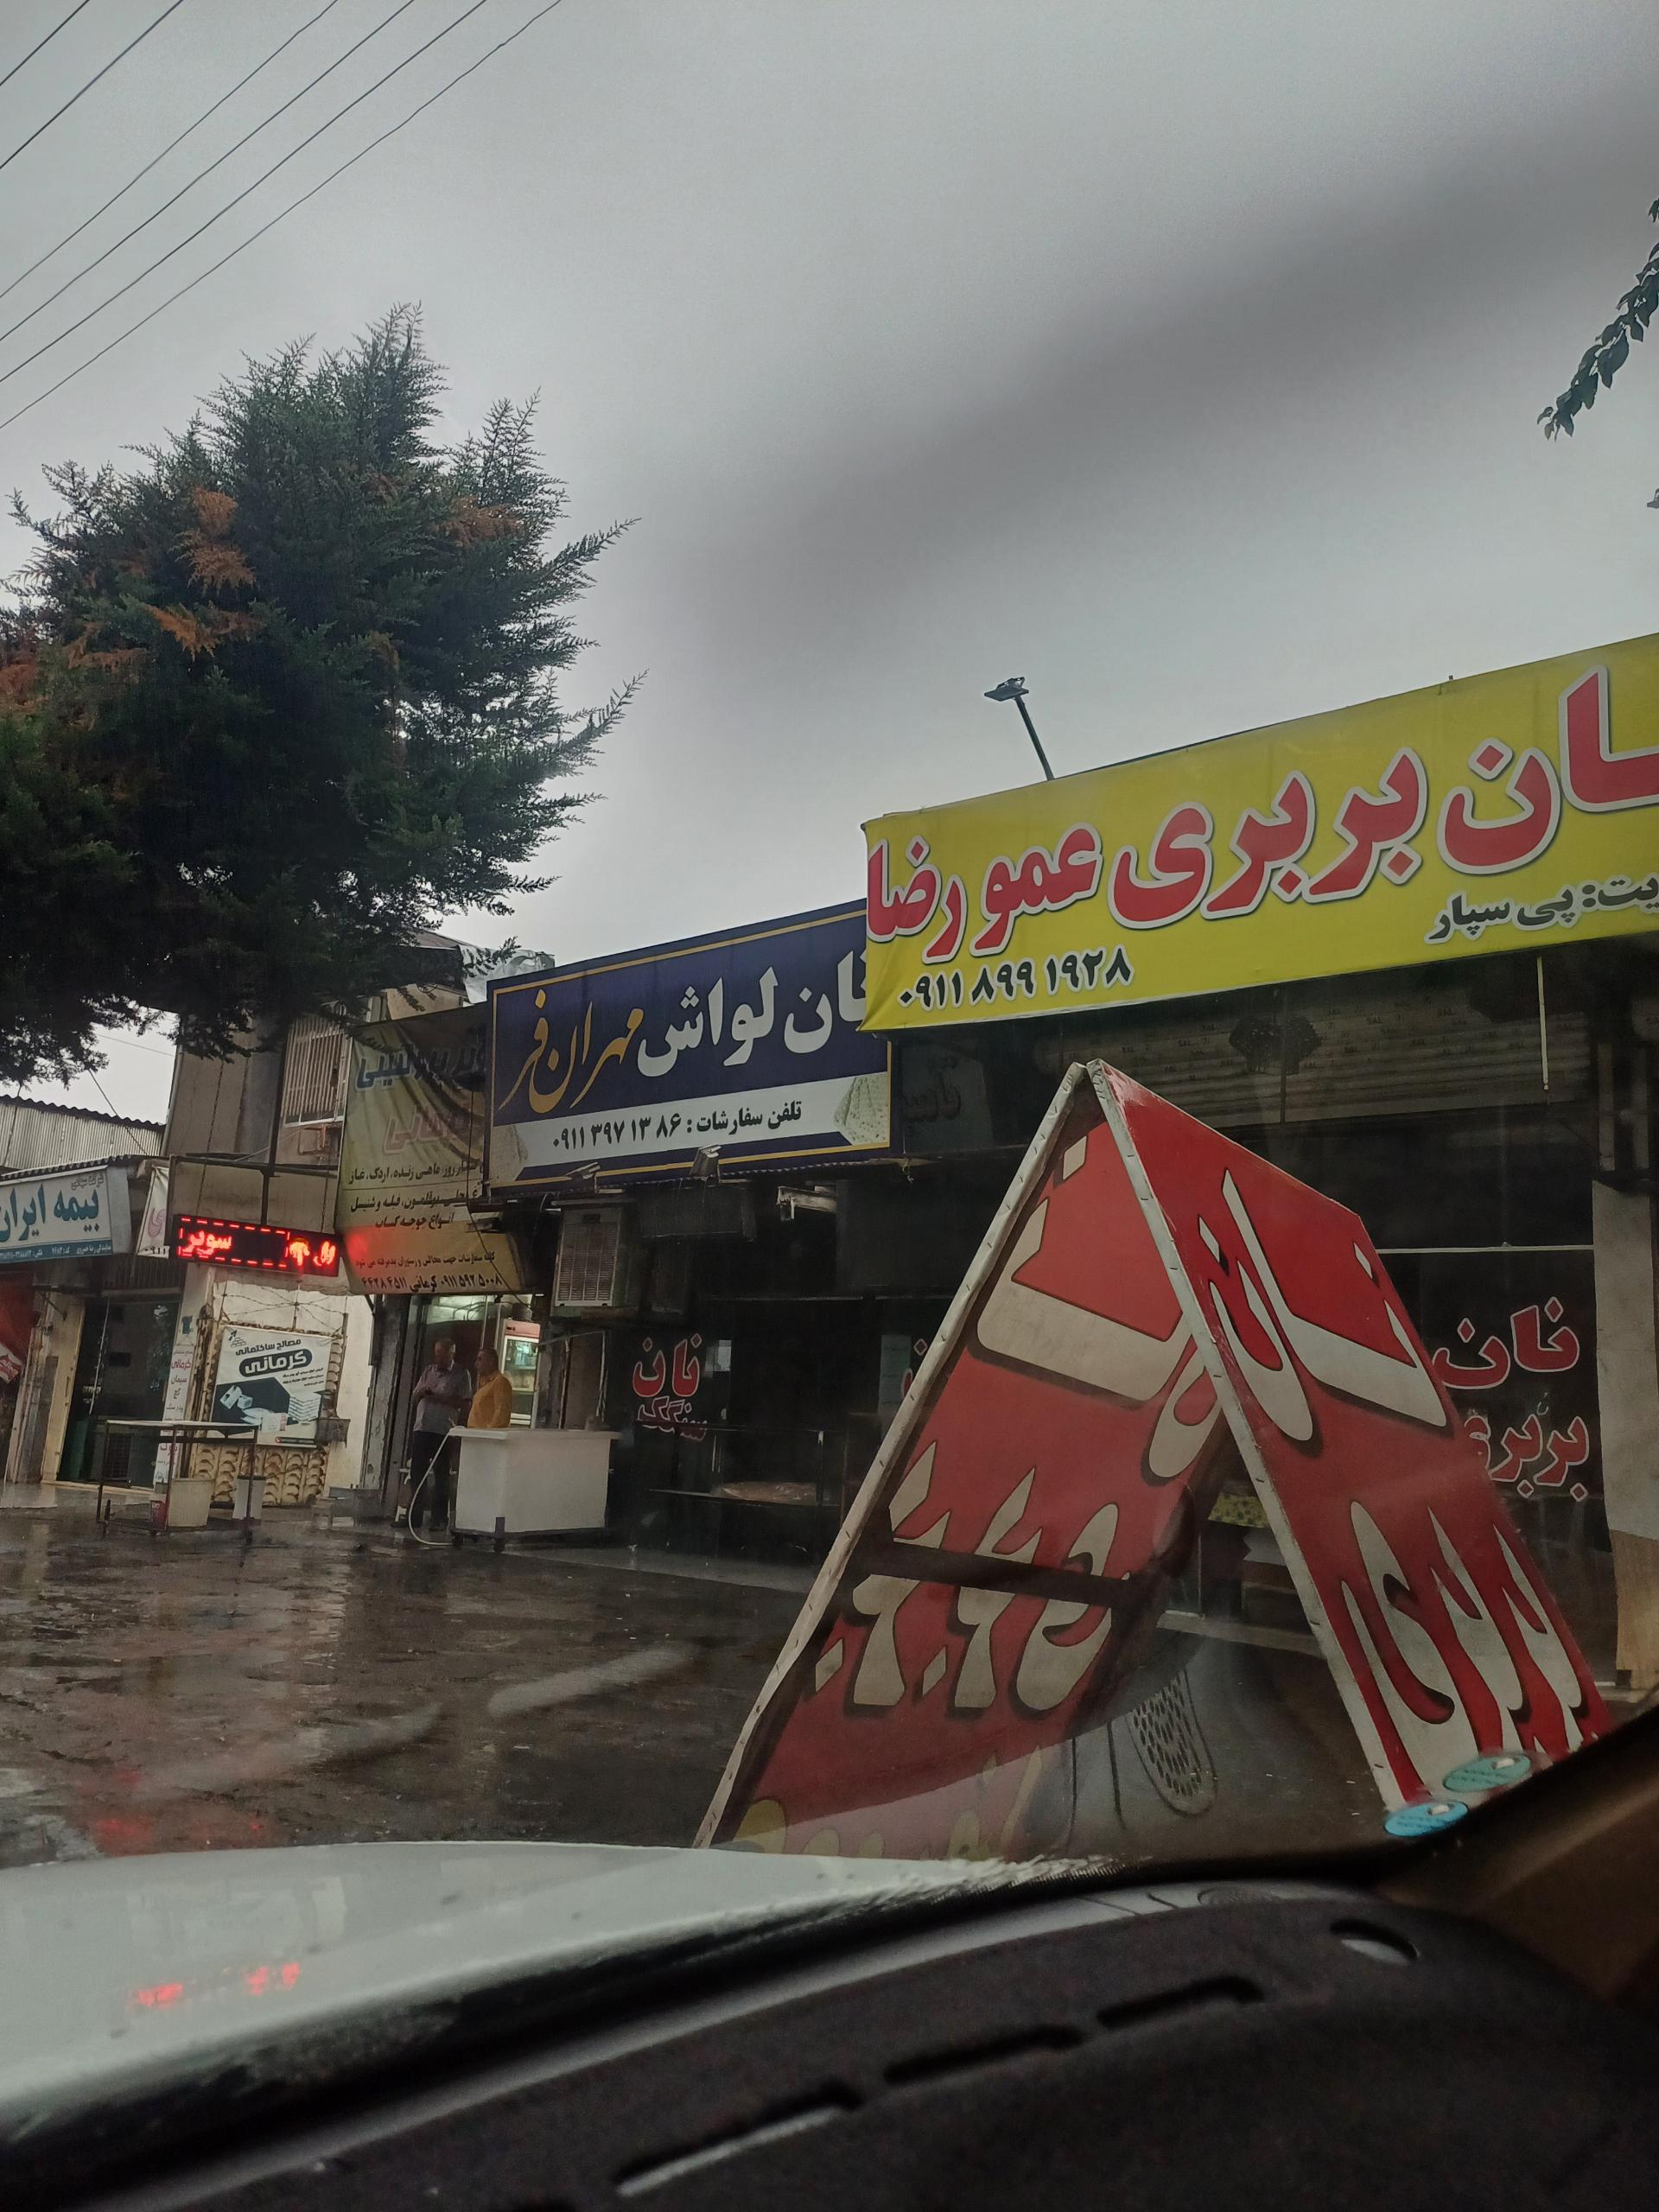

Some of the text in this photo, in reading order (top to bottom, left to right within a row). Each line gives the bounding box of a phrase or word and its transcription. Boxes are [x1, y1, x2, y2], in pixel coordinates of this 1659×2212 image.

[866, 665, 1659, 965] ان بربری عمو رضا
[1426, 893, 1512, 941] سپار
[898, 946, 1133, 1009] ۰۹۱۱ ۸۹۹ ۱۹۲۸
[498, 950, 868, 1115] ان لواش مهران فر
[767, 1099, 803, 1130] تلفن
[54, 1189, 101, 1233] بیمه
[235, 1338, 302, 1357] مصالح ساختمانی
[245, 1351, 308, 1375] کرمانی
[632, 1332, 703, 1398] نان
[1431, 1296, 1580, 1390] نان
